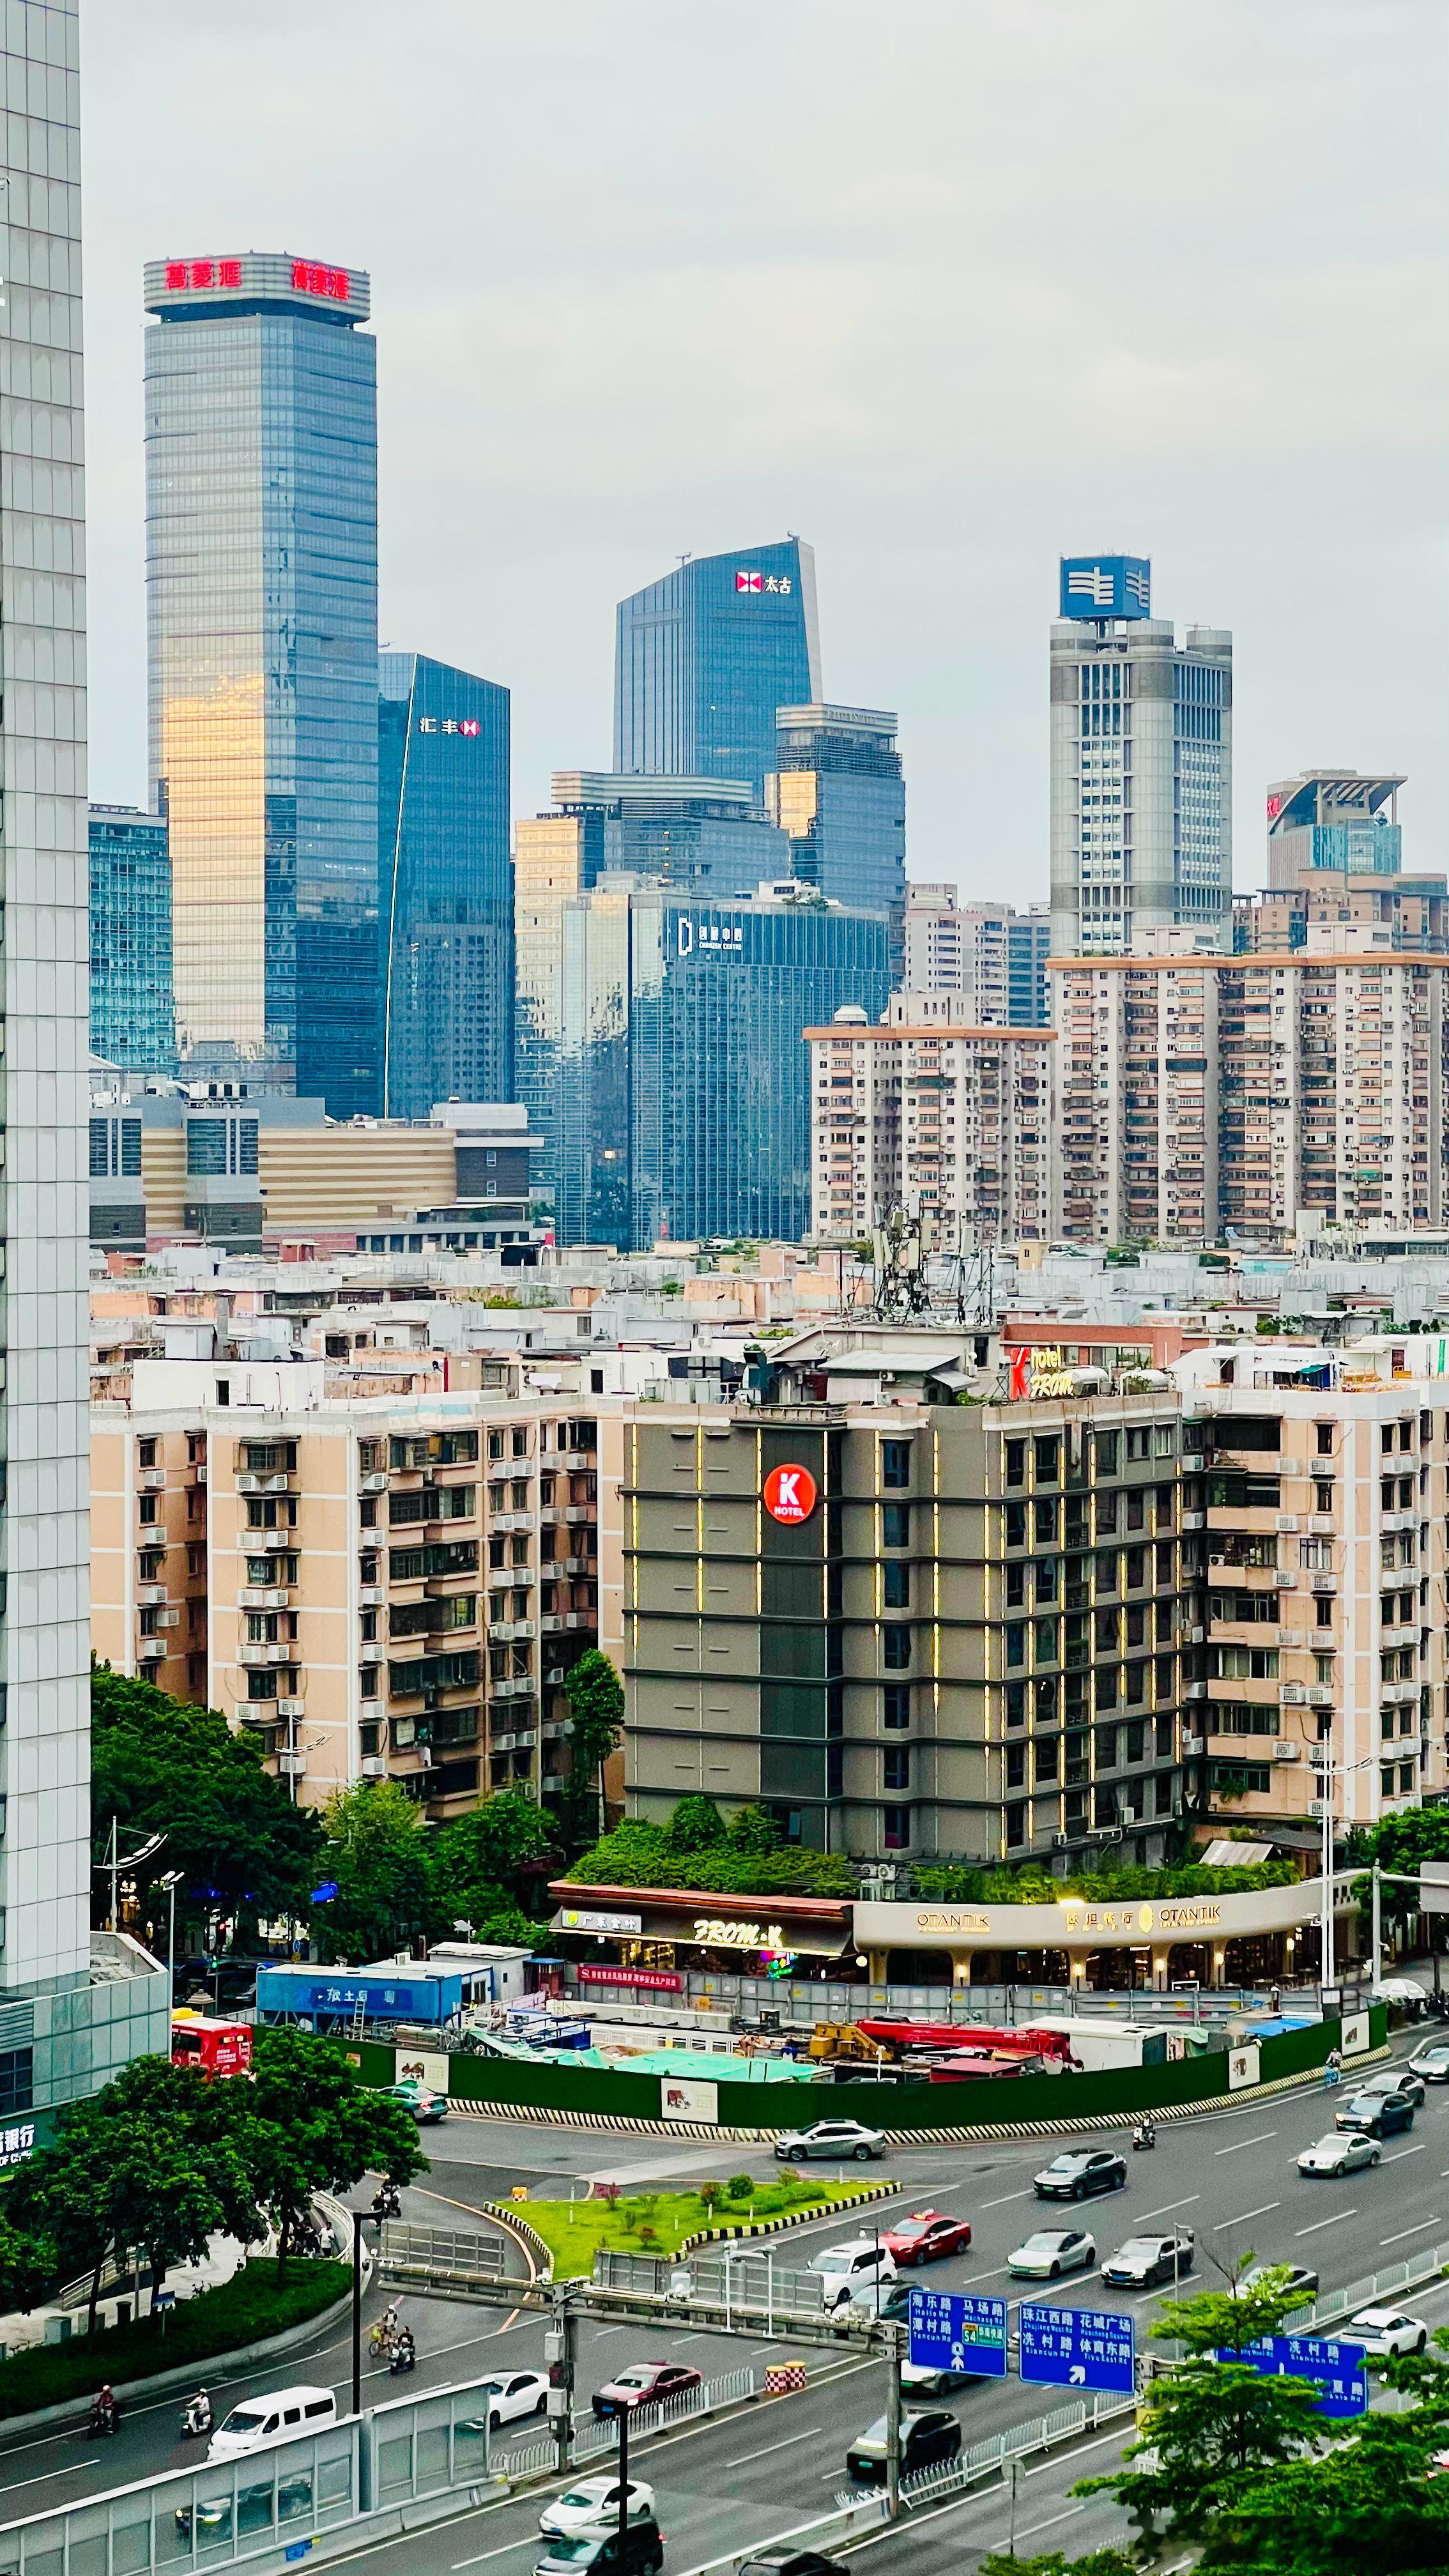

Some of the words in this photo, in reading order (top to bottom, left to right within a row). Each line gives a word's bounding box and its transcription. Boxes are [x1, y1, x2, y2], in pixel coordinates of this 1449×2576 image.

[765, 575, 792, 594] 太古
[420, 717, 458, 734] 汇丰
[1031, 1345, 1061, 1368] hotel
[1011, 1347, 1031, 1400] K
[780, 1473, 800, 1505] K
[774, 1506, 804, 1517] HOTEL
[917, 1914, 990, 1926] OTANTIK
[1160, 1905, 1220, 1921] OTANTIK
[939, 2310, 949, 2319] Rd
[963, 2300, 1002, 2317] 马场路
[1022, 2308, 1073, 2326] 珠江西路
[1080, 2313, 1130, 2332] 花城广场
[942, 2334, 951, 2343] Rd
[964, 2330, 976, 2343] S4
[1060, 2350, 1070, 2359] Rd
[1080, 2338, 1130, 2358] 体育东路
